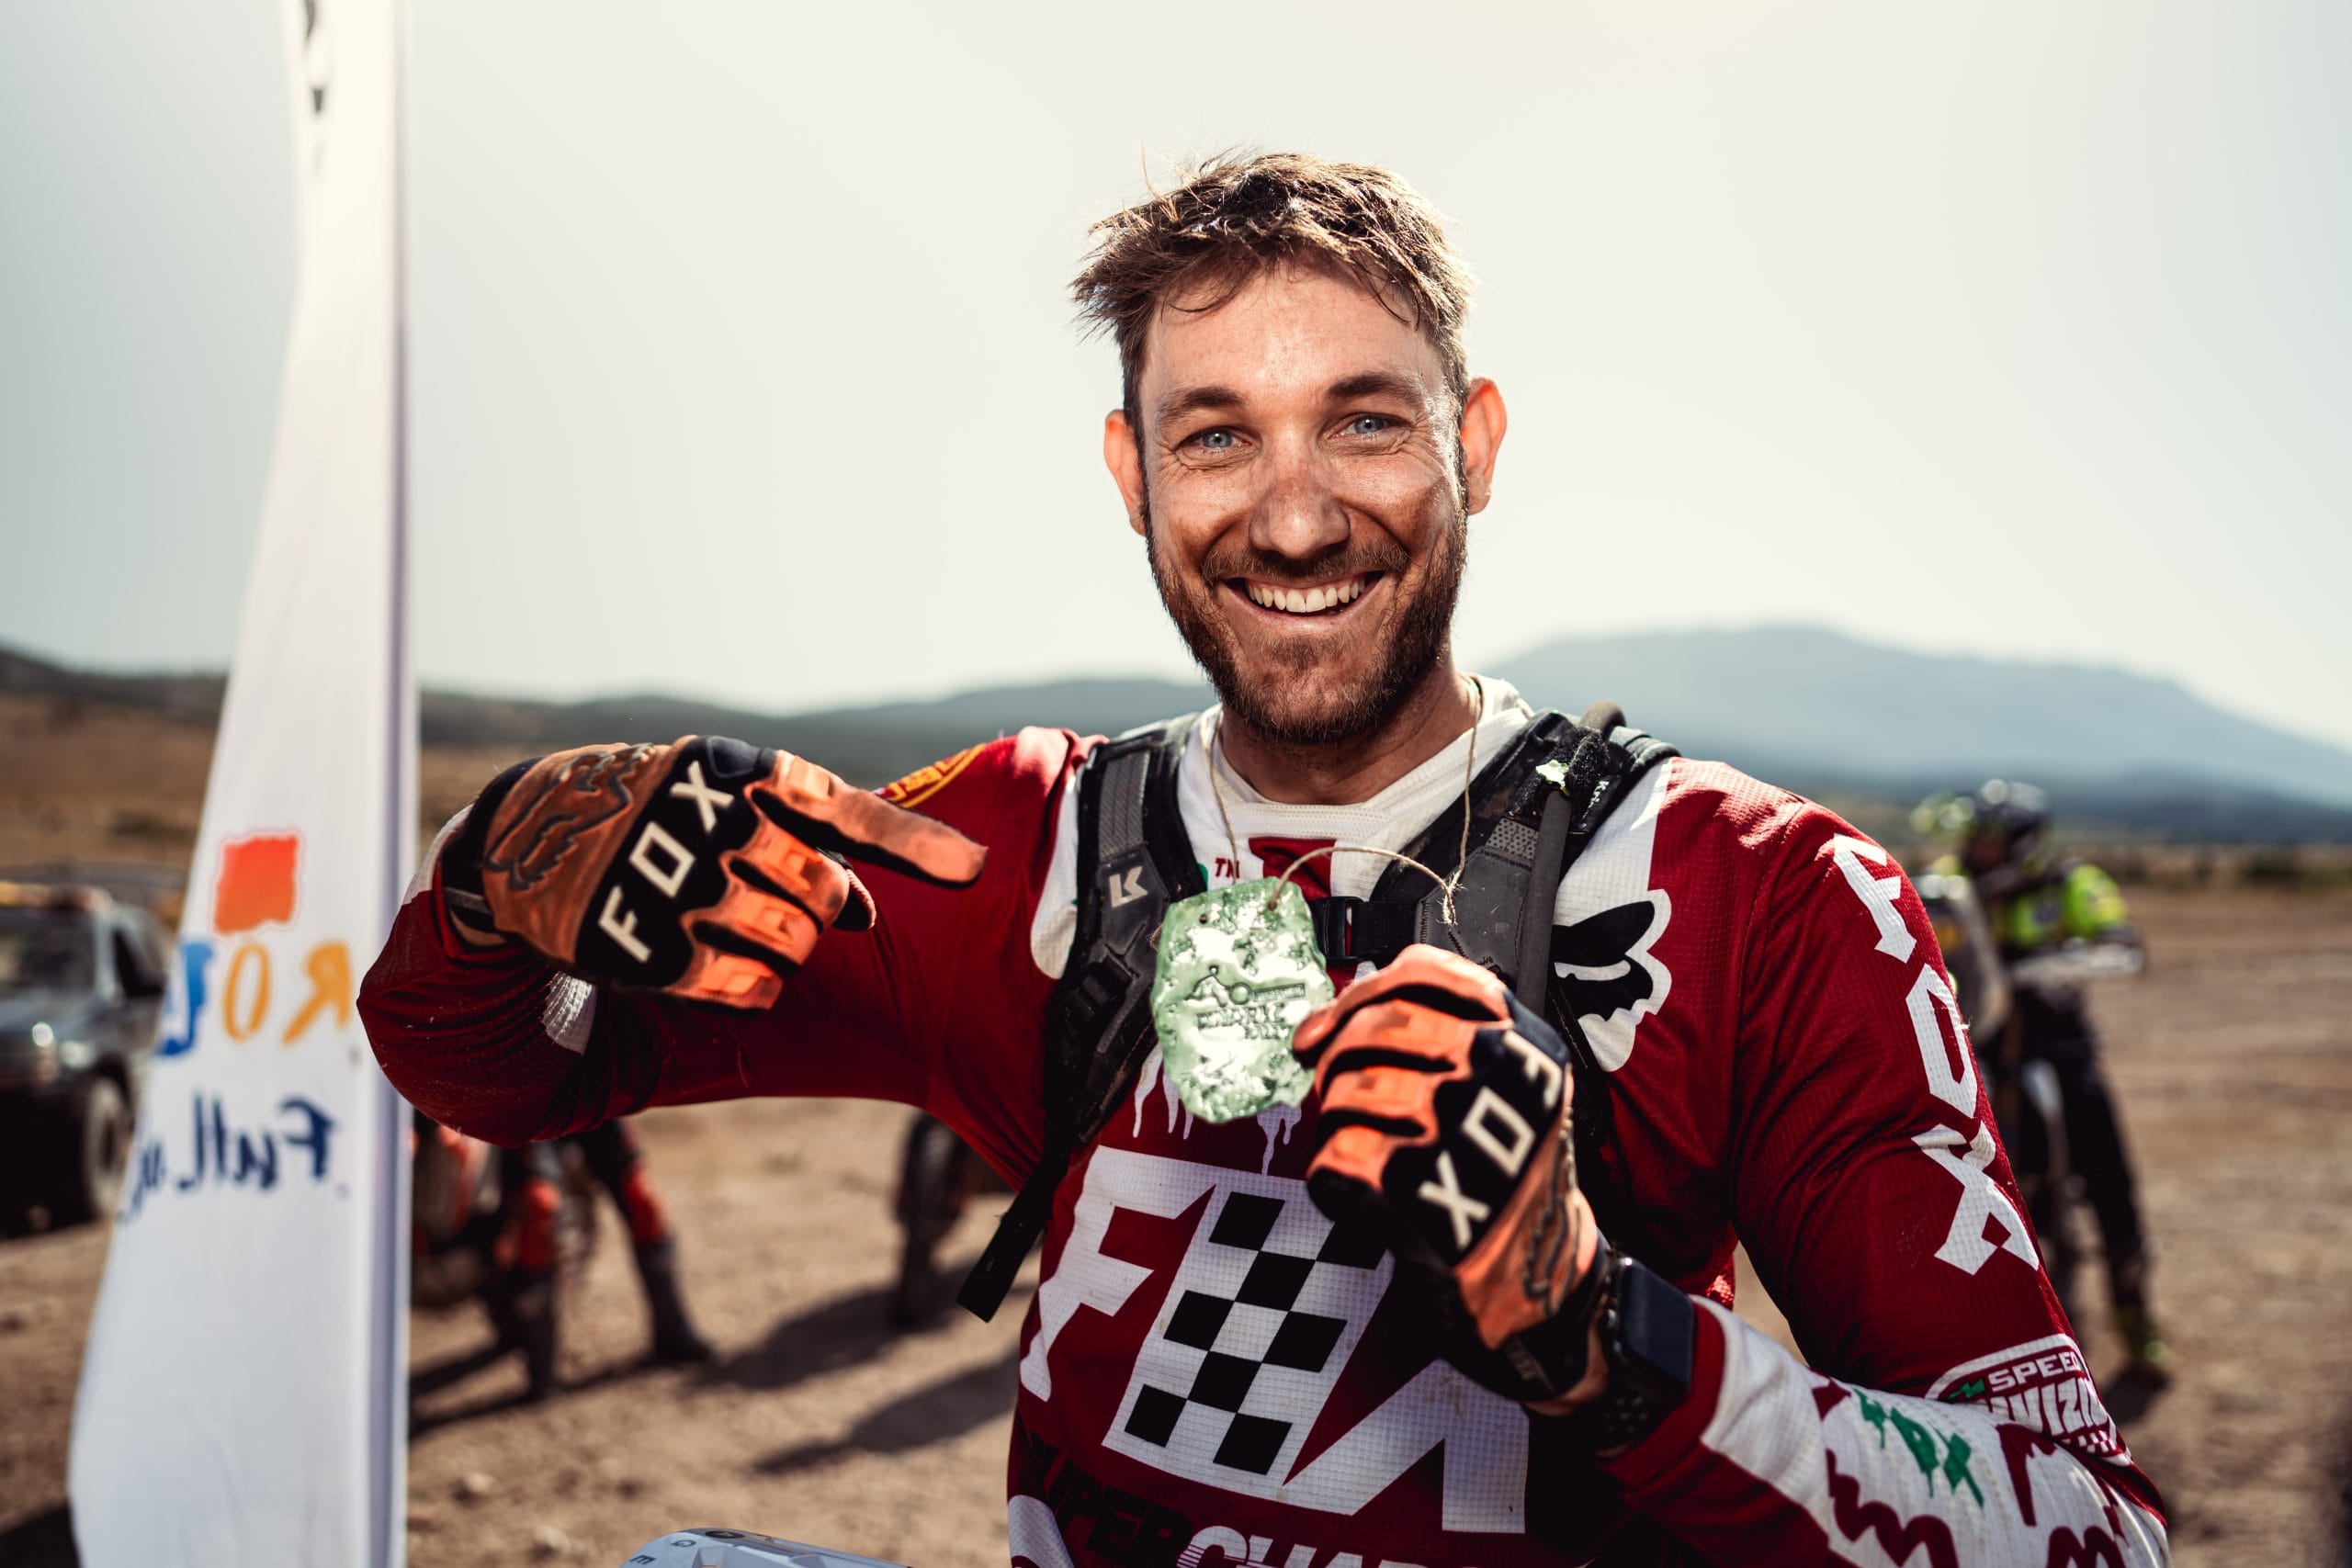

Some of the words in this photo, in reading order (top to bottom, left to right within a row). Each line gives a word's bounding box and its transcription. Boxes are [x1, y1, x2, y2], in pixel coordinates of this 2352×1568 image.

[599, 761, 734, 963] FOX
[1417, 1029, 1563, 1250] FOX
[1833, 833, 2039, 1276] FOX
